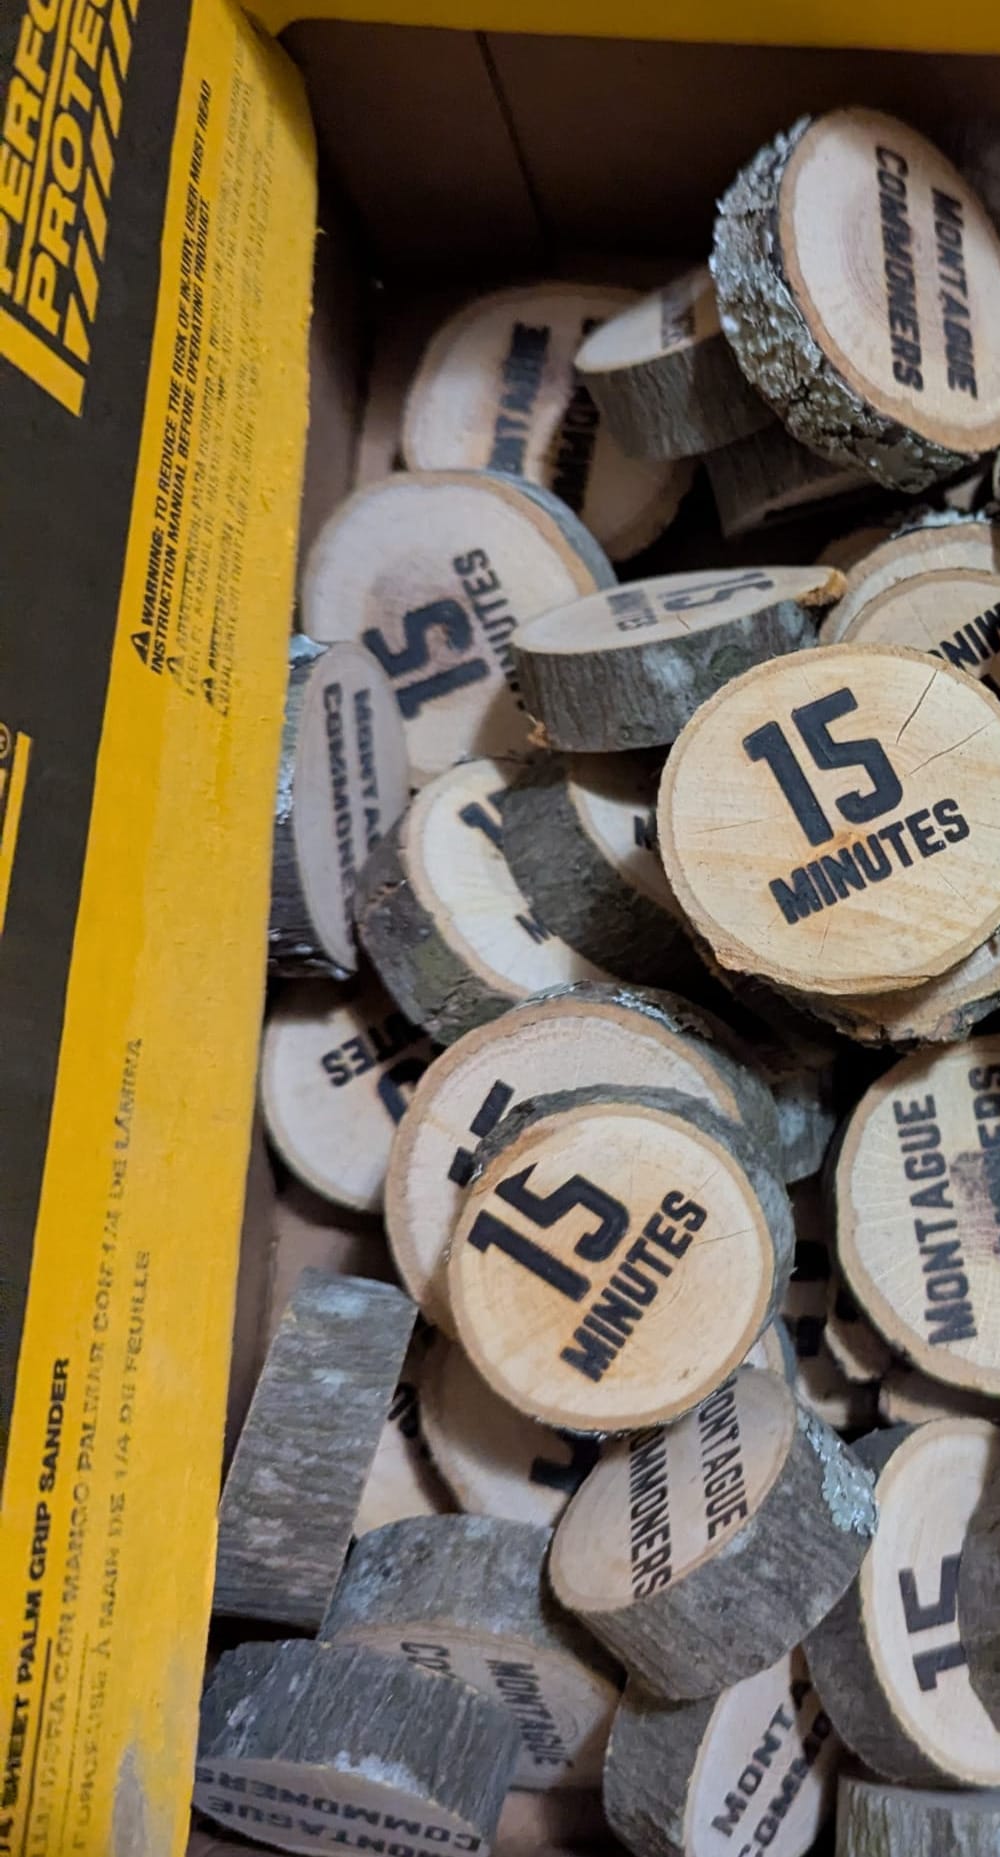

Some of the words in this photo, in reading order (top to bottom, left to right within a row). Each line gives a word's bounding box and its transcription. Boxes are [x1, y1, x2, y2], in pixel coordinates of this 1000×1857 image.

[190, 130, 205, 184] MUST
[197, 80, 211, 131] READ
[27, 0, 105, 337] PROTE
[185, 183, 199, 233] USER
[178, 305, 189, 329] OF
[875, 144, 925, 393] COMMONERS
[930, 186, 979, 400] MONTAGUE
[167, 376, 182, 414] THE
[172, 333, 186, 378] RISK
[151, 544, 176, 675] INSTRUCTION
[167, 464, 187, 543] MANUAL
[177, 386, 195, 459] BEFORE
[187, 285, 204, 385] OPERATING
[155, 496, 167, 521] TO
[158, 415, 177, 495] REDUCE
[141, 527, 163, 626] WARNING:
[362, 598, 491, 720] 15
[742, 686, 905, 848] 15
[768, 797, 971, 927] MINUTES
[467, 1160, 630, 1303] 15
[892, 1092, 978, 1347] MONTAGUE
[559, 1188, 709, 1385] MINUTES
[39, 1357, 69, 1493] SANDER
[28, 1501, 52, 1581] GRIP
[629, 1423, 674, 1600] OMMONERS
[16, 1589, 42, 1686] PALM
[0, 1696, 30, 1810] SHEET
[485, 1658, 573, 1771] MONTAGUE
